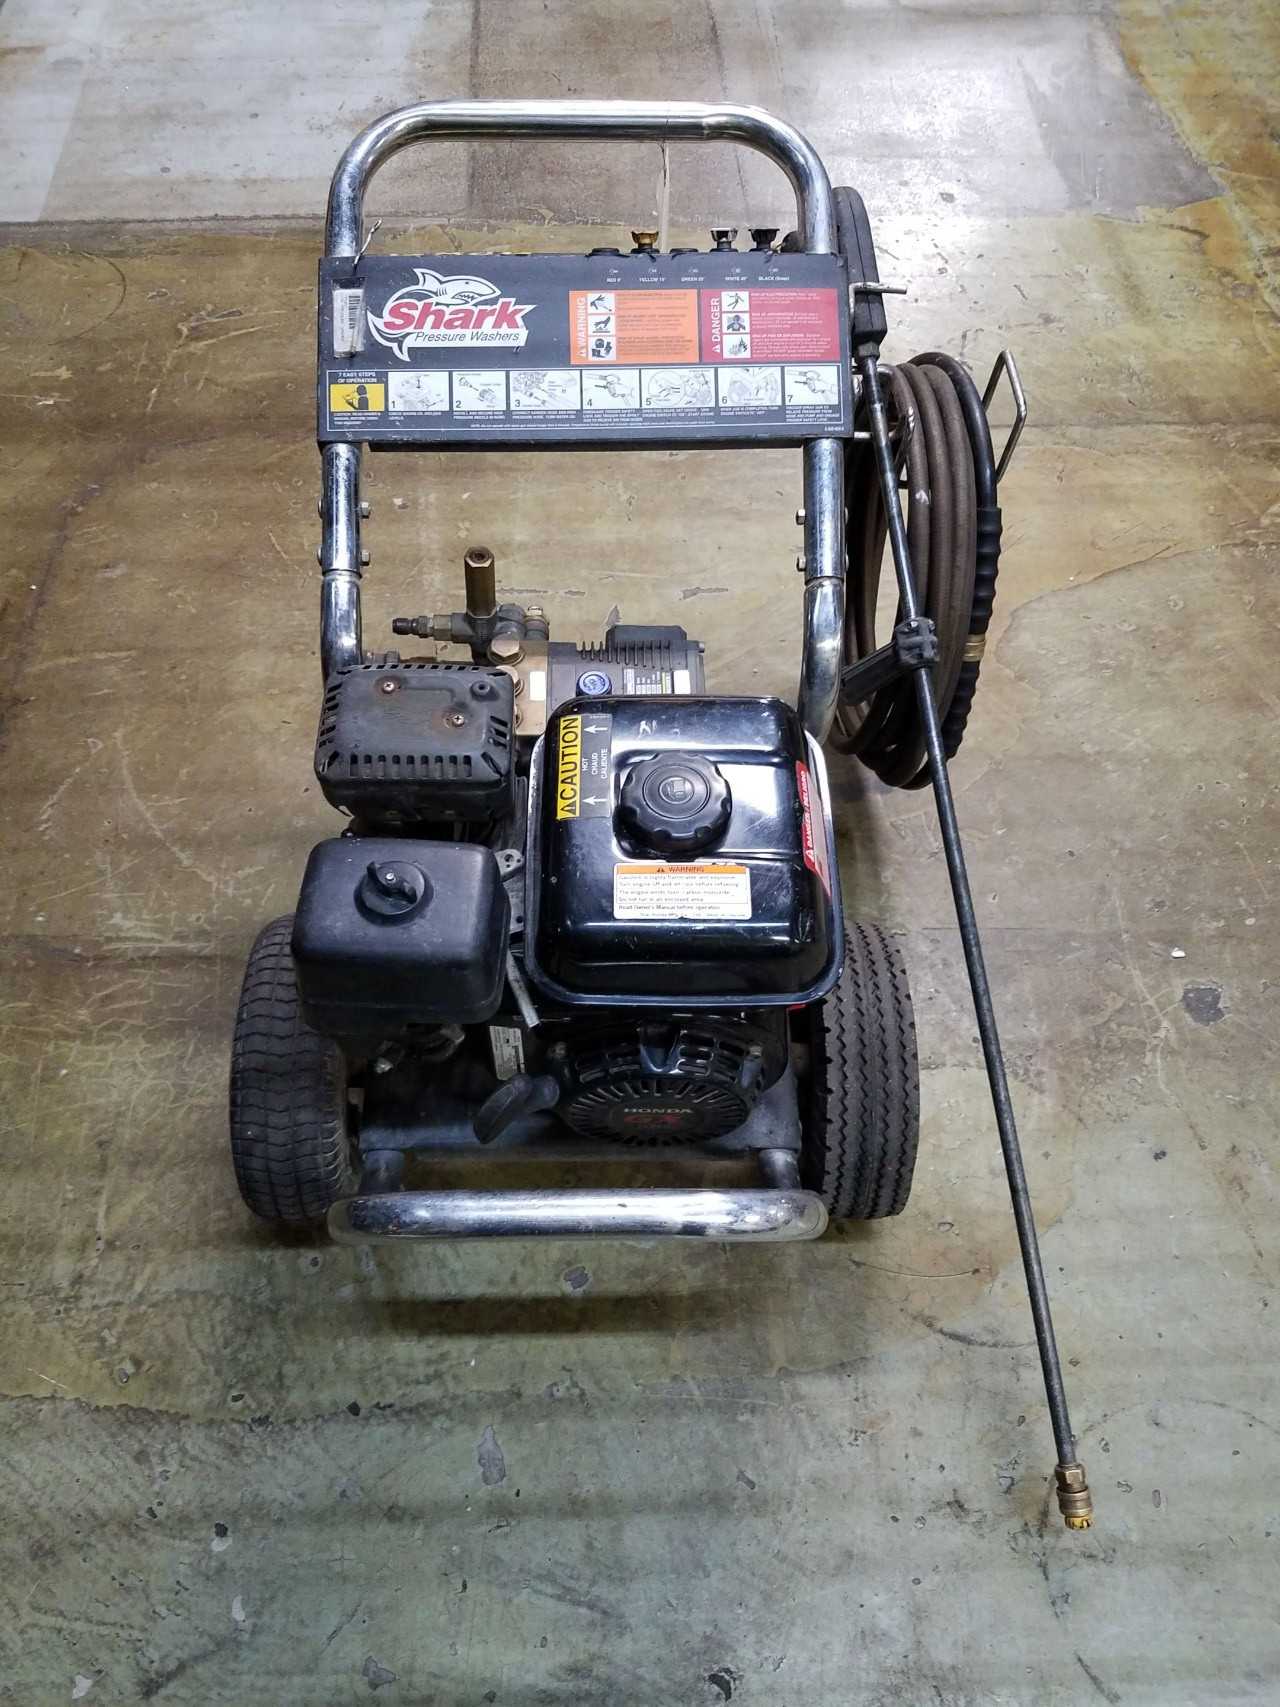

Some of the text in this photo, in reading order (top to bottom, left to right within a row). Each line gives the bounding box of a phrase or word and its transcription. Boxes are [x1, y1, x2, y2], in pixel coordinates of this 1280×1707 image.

[383, 300, 526, 331] Shark
[711, 297, 721, 342] DANGER
[576, 297, 586, 348] WARNING
[414, 331, 520, 342] Pressure Washers
[514, 399, 521, 408] 3
[587, 399, 593, 407] 4
[645, 398, 652, 406] 5
[721, 396, 728, 404] 6
[787, 394, 793, 403] 7
[391, 400, 396, 408] 1
[455, 400, 462, 408] 2
[560, 717, 578, 801] CAUTION
[591, 752, 599, 775] CHAUD
[600, 748, 608, 779] CALIENTE
